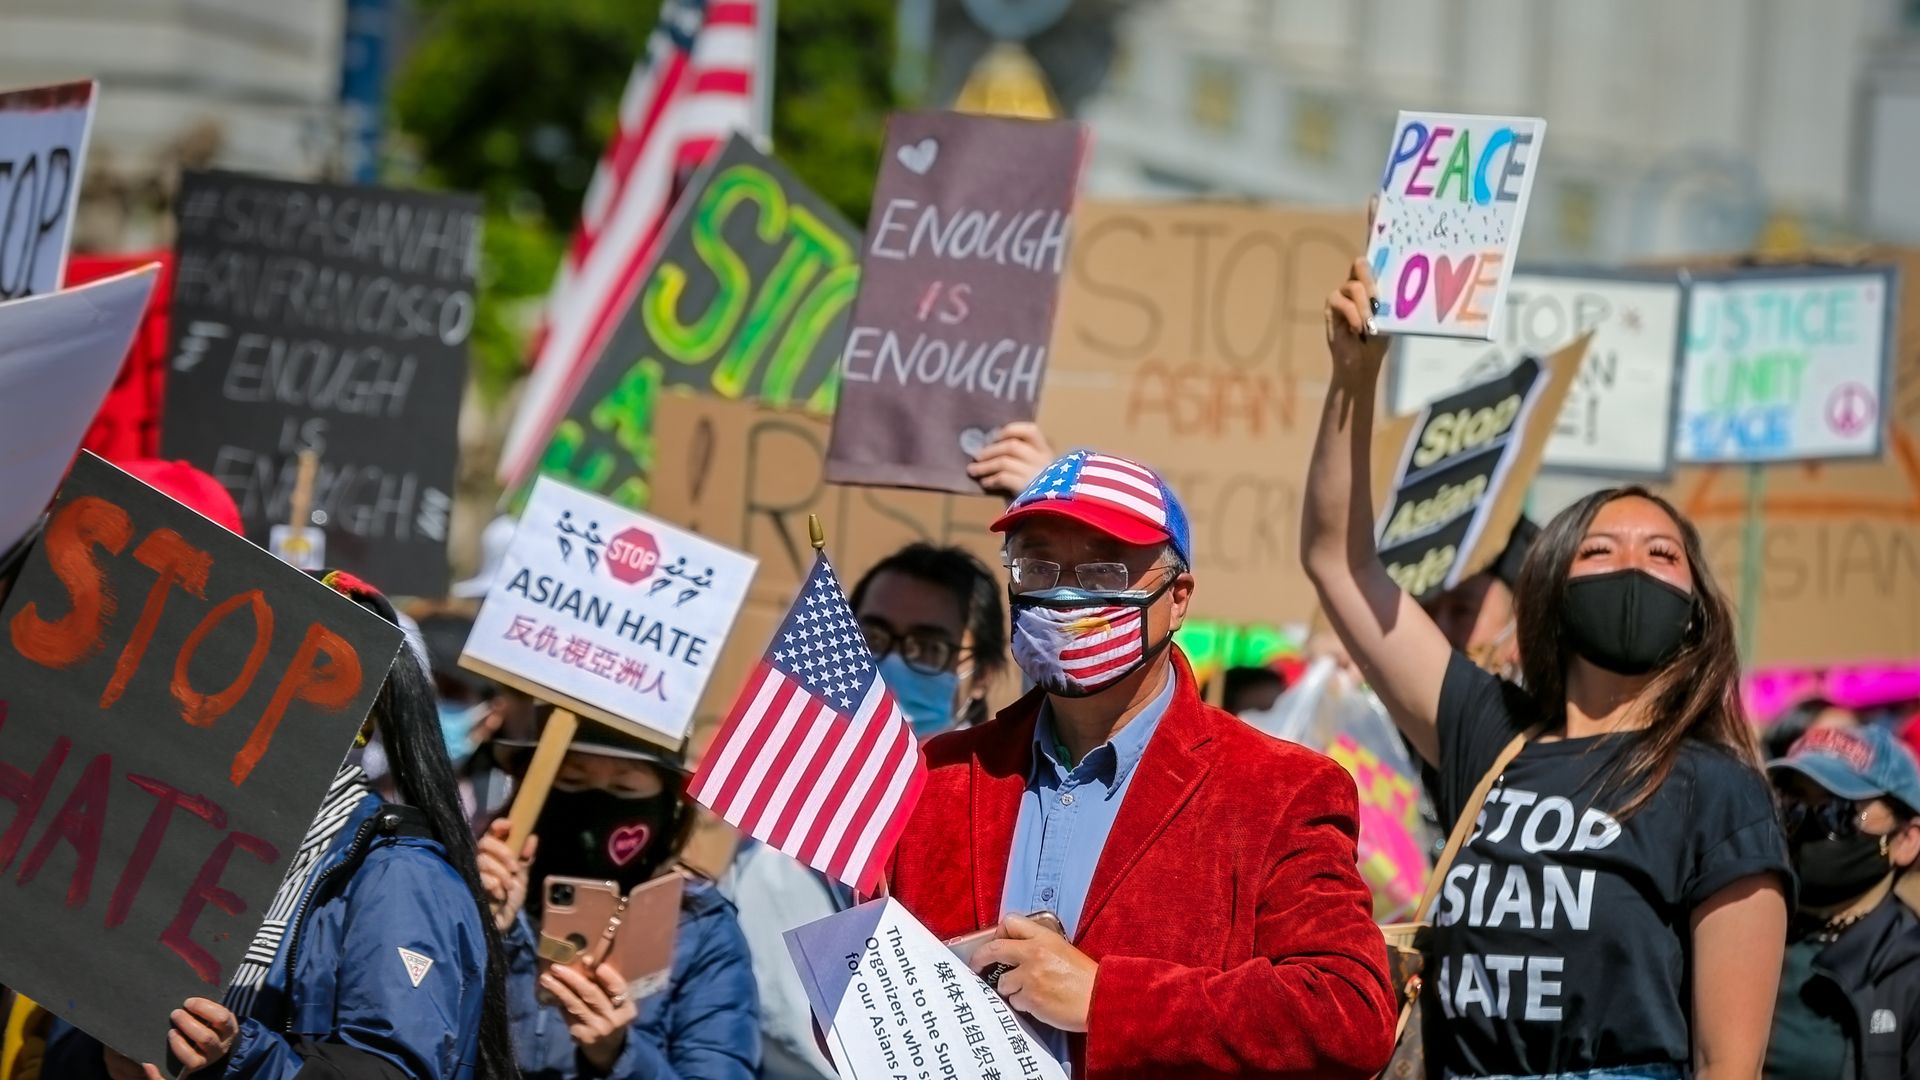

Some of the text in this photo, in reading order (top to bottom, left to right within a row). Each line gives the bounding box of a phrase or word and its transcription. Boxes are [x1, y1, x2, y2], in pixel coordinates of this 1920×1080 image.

[1383, 120, 1534, 206] PEACE
[869, 198, 1074, 274] ENOUGH
[1433, 211, 1449, 240] &
[916, 280, 972, 325] IS
[1072, 214, 1364, 371] STOP
[1504, 289, 1613, 350] TOP
[1684, 286, 1861, 353] USTICE
[222, 332, 419, 418] ENOUGH
[837, 325, 1047, 403] ENOUGH
[1124, 357, 1298, 440] ASIAN
[277, 415, 330, 456] IS
[1413, 393, 1522, 468] Stop
[1384, 473, 1488, 544] Asian
[607, 538, 657, 573] STOP
[1386, 544, 1457, 596] ate
[9, 495, 363, 787] STOP
[505, 567, 708, 667] ASIAN HATE
[503, 613, 668, 702] 反仇視亞洲人
[0, 708, 281, 987] HATE
[845, 952, 863, 978] for
[857, 982, 877, 1011] our
[870, 1015, 899, 1071] Asians
[865, 936, 908, 1027] Organizers
[903, 1029, 925, 1068] who
[886, 925, 918, 986] Thanks
[912, 988, 926, 1008] to
[921, 1010, 940, 1040] the
